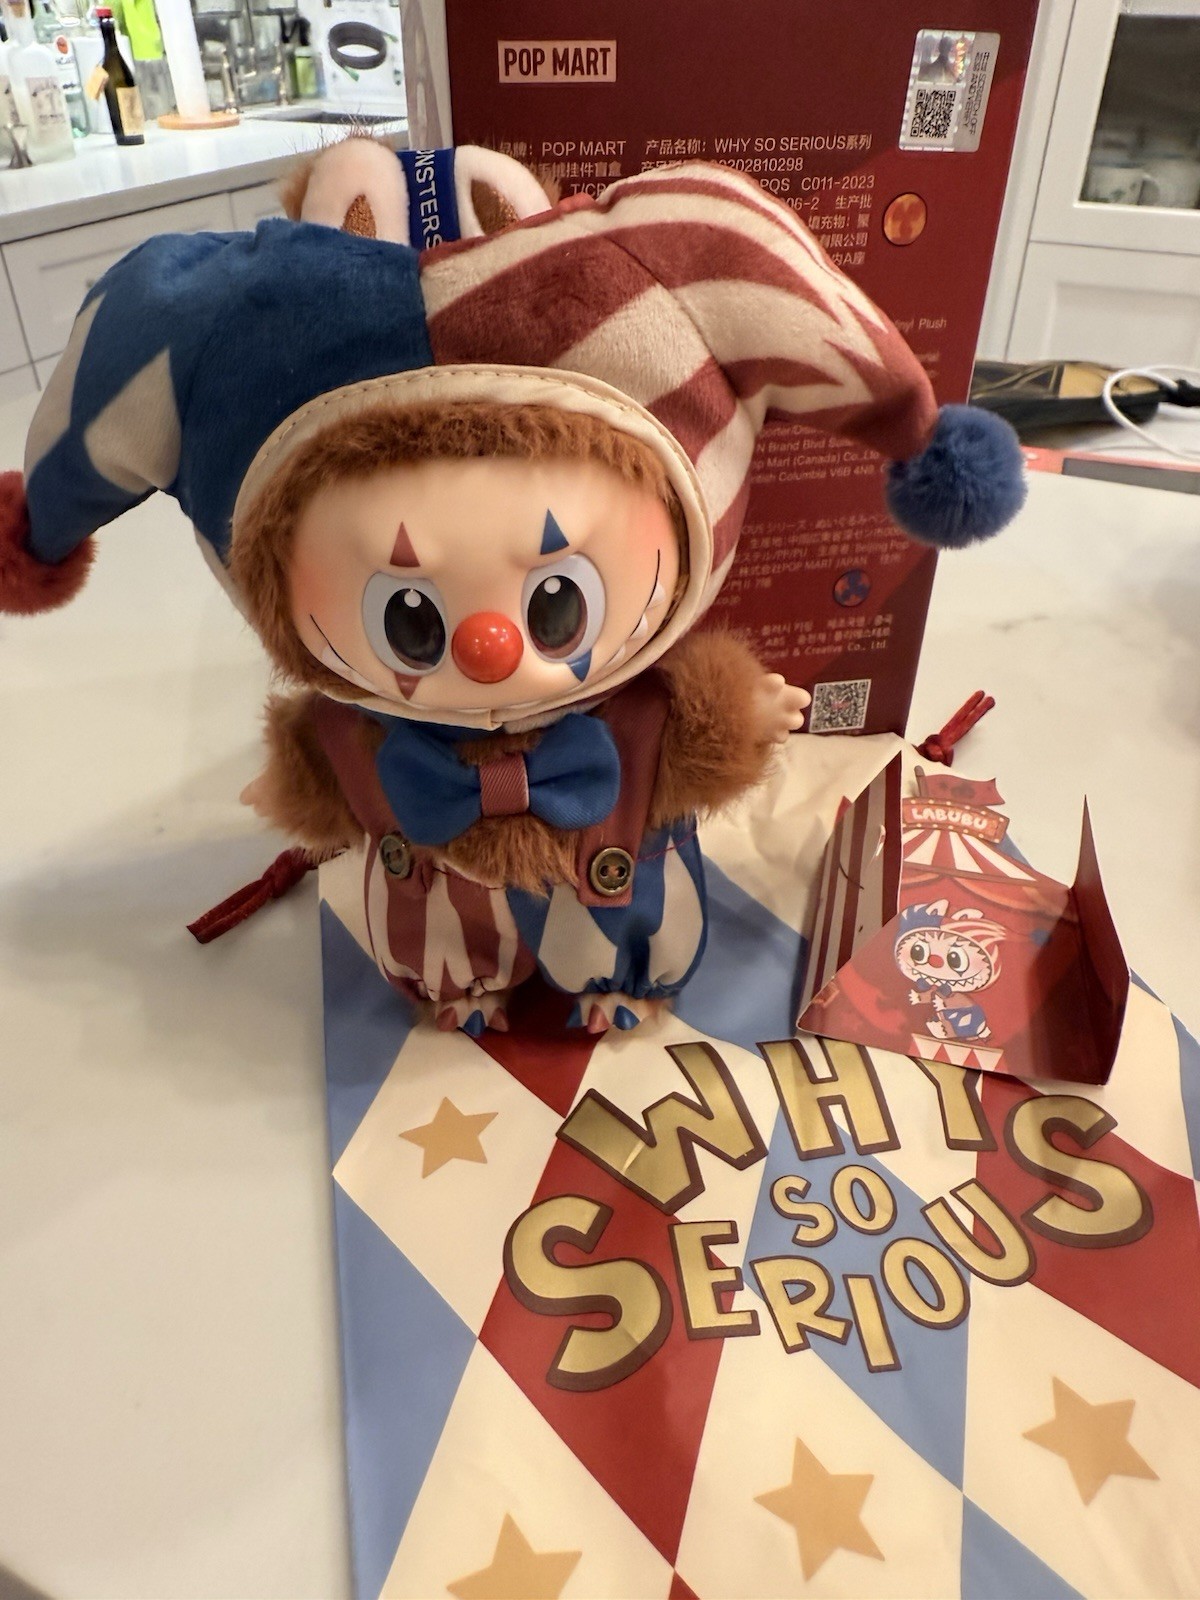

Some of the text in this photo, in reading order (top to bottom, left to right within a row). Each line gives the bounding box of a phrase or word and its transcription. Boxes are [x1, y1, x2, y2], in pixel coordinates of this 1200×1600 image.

[504, 47, 611, 76] POP MART
[968, 73, 979, 94] AND
[963, 95, 975, 127] VERIFY
[969, 117, 978, 135] OFF
[541, 141, 576, 157] POP
[580, 140, 627, 156] MART
[714, 137, 751, 153] WHY
[754, 137, 776, 152] SO
[801, 175, 875, 191] C011-2023
[918, 317, 947, 329] Plush
[911, 807, 988, 829] LABUBU
[555, 1040, 998, 1216] WHY
[770, 1164, 898, 1248] SO
[503, 1094, 1154, 1392] SERIOUS
